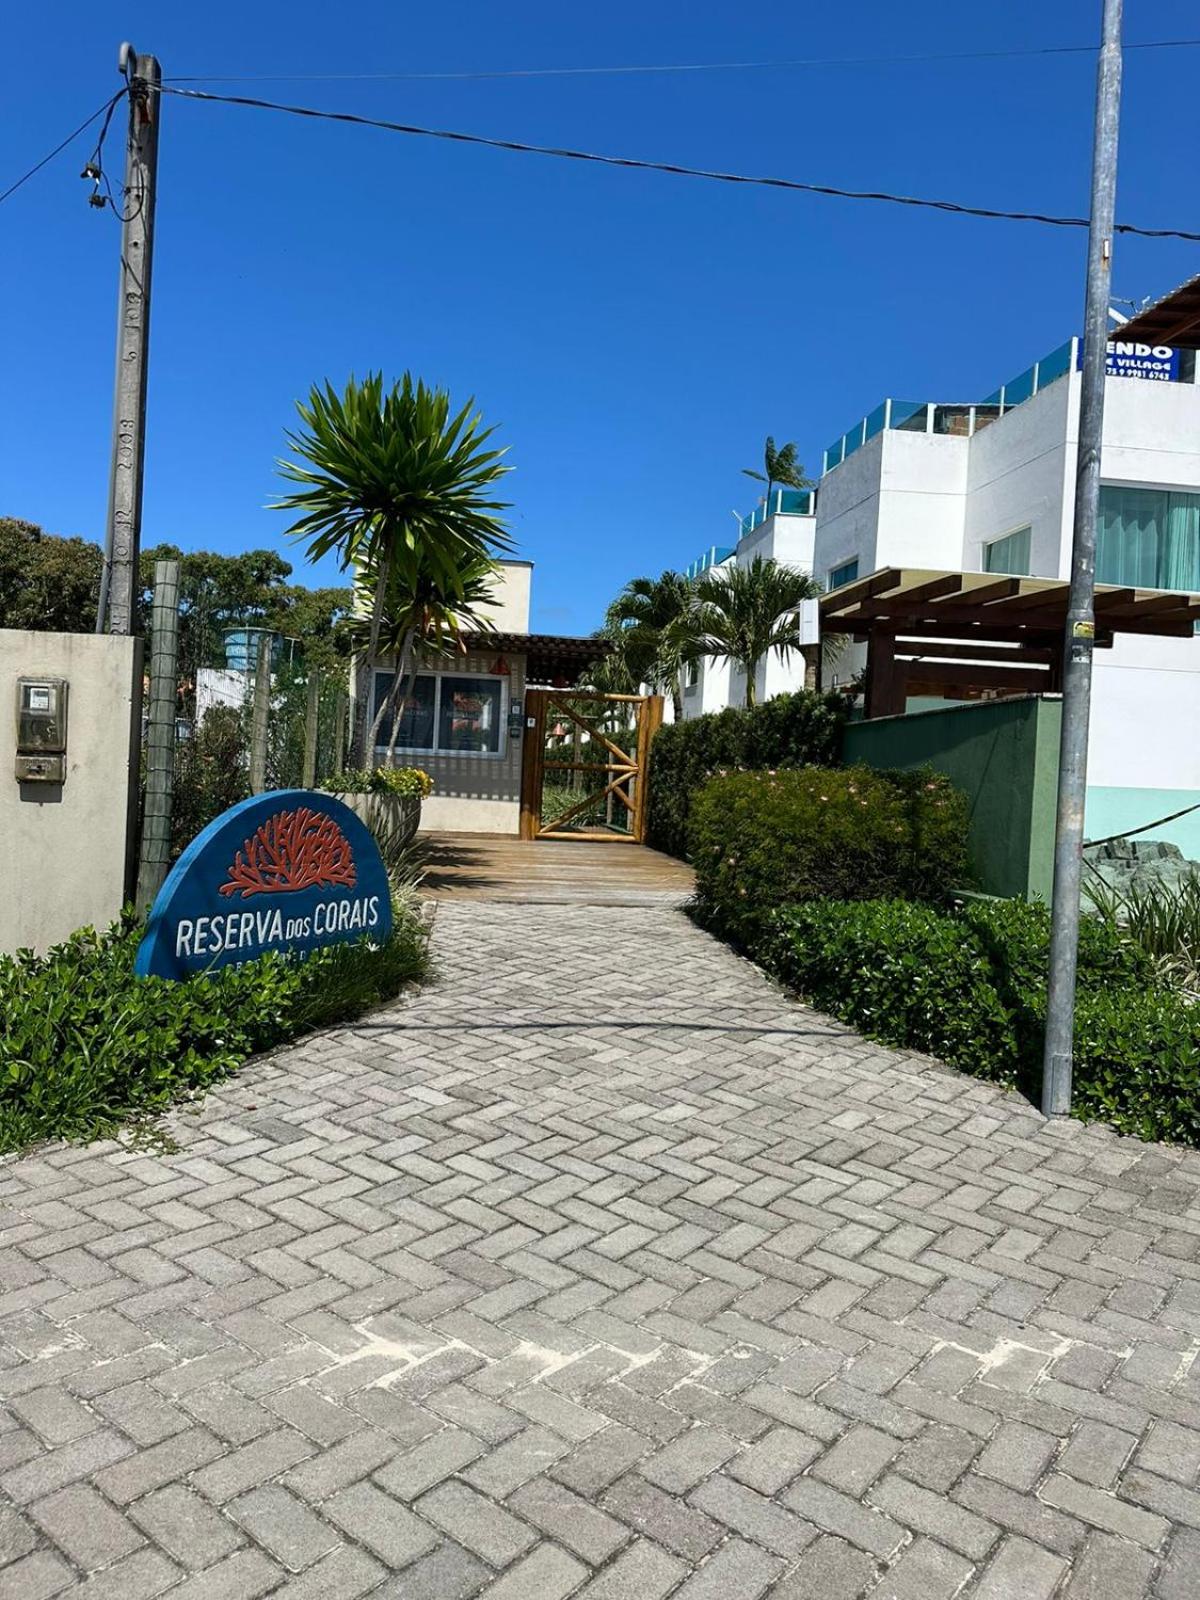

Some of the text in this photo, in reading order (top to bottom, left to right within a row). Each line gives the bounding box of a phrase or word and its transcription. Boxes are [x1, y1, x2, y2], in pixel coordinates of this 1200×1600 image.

[1106, 341, 1173, 359] ENDO
[1117, 359, 1170, 370] VILLAGE
[176, 896, 379, 958] RESERVA DOS CORAIS
